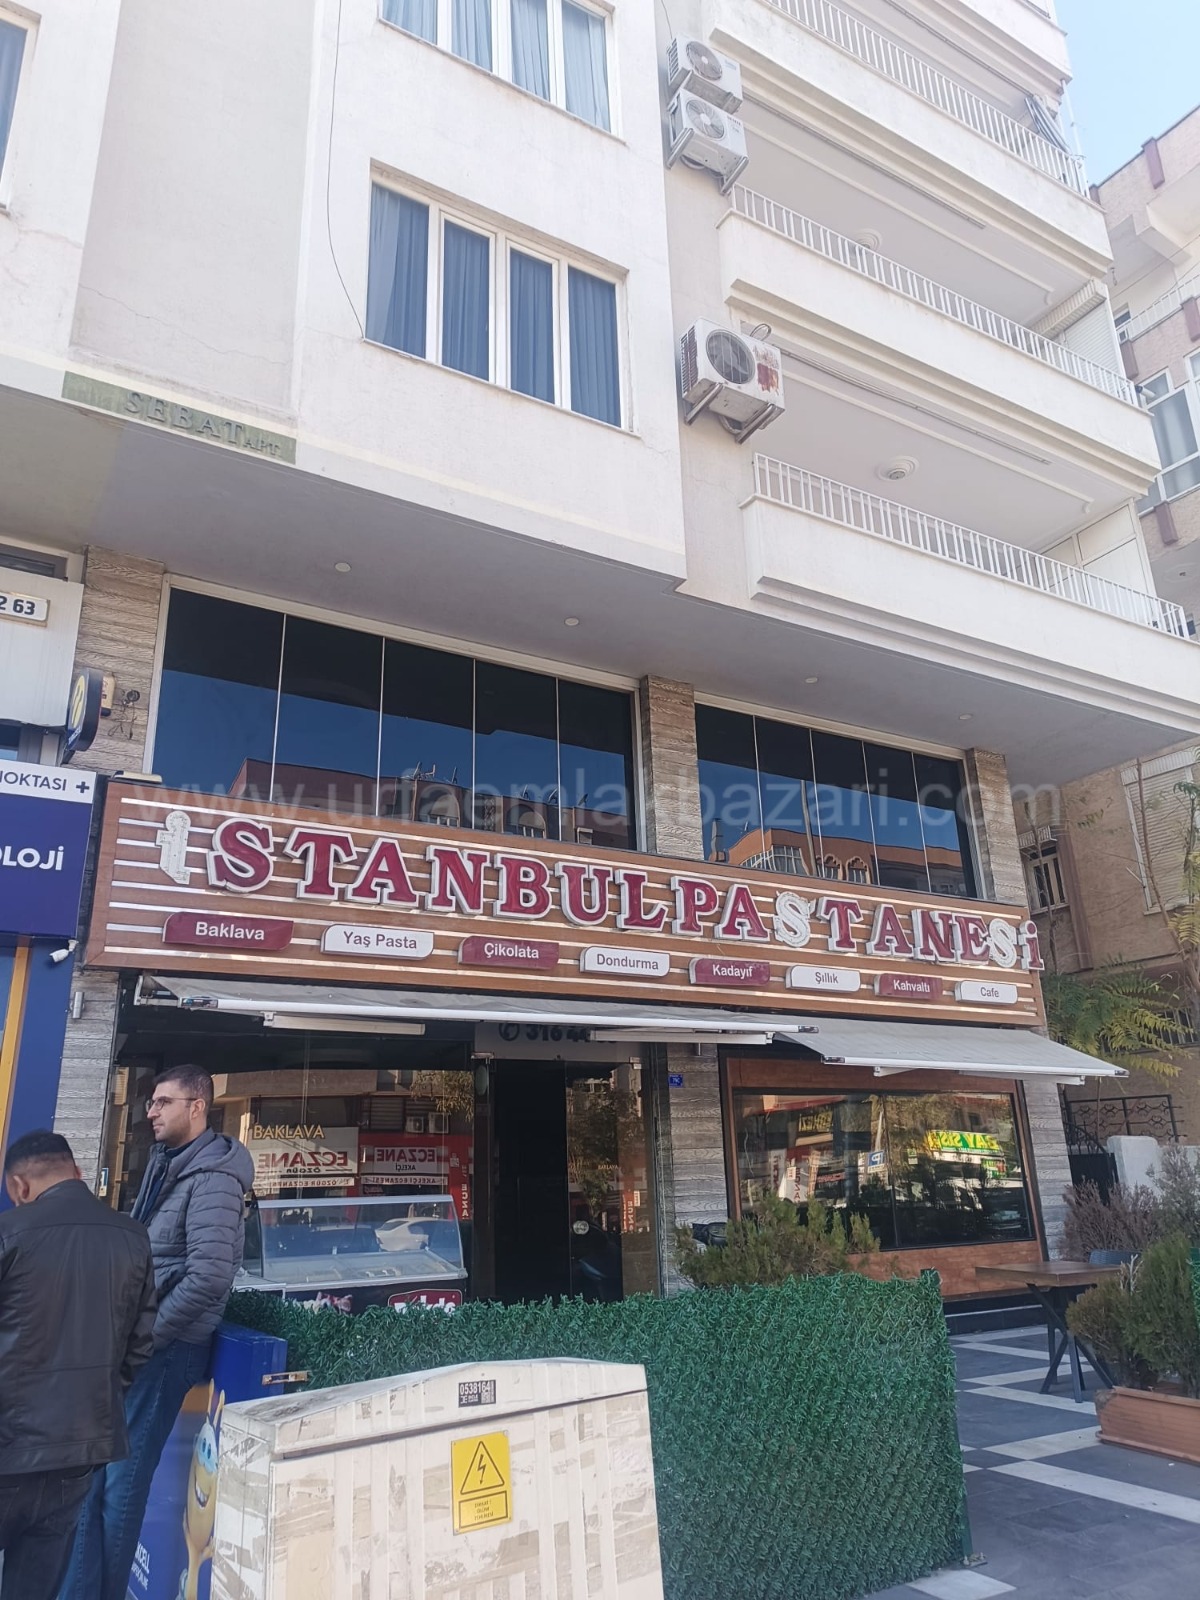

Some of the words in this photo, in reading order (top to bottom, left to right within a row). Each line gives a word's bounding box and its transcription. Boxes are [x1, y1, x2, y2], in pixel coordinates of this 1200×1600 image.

[125, 391, 244, 444] SEBAT
[13, 598, 36, 616] 63
[0, 845, 65, 871] LOJi
[195, 921, 265, 941] Baklava
[343, 931, 371, 948] Yaş
[376, 934, 418, 950] Pasta
[484, 942, 539, 961] Çikolata
[596, 953, 659, 971] Dondurma
[712, 963, 753, 979] Kadayıf
[814, 971, 839, 985] Şıllık
[893, 979, 931, 994] Kahvaltı
[980, 986, 1000, 998] Cafe
[252, 1125, 325, 1140] BAKLAVA
